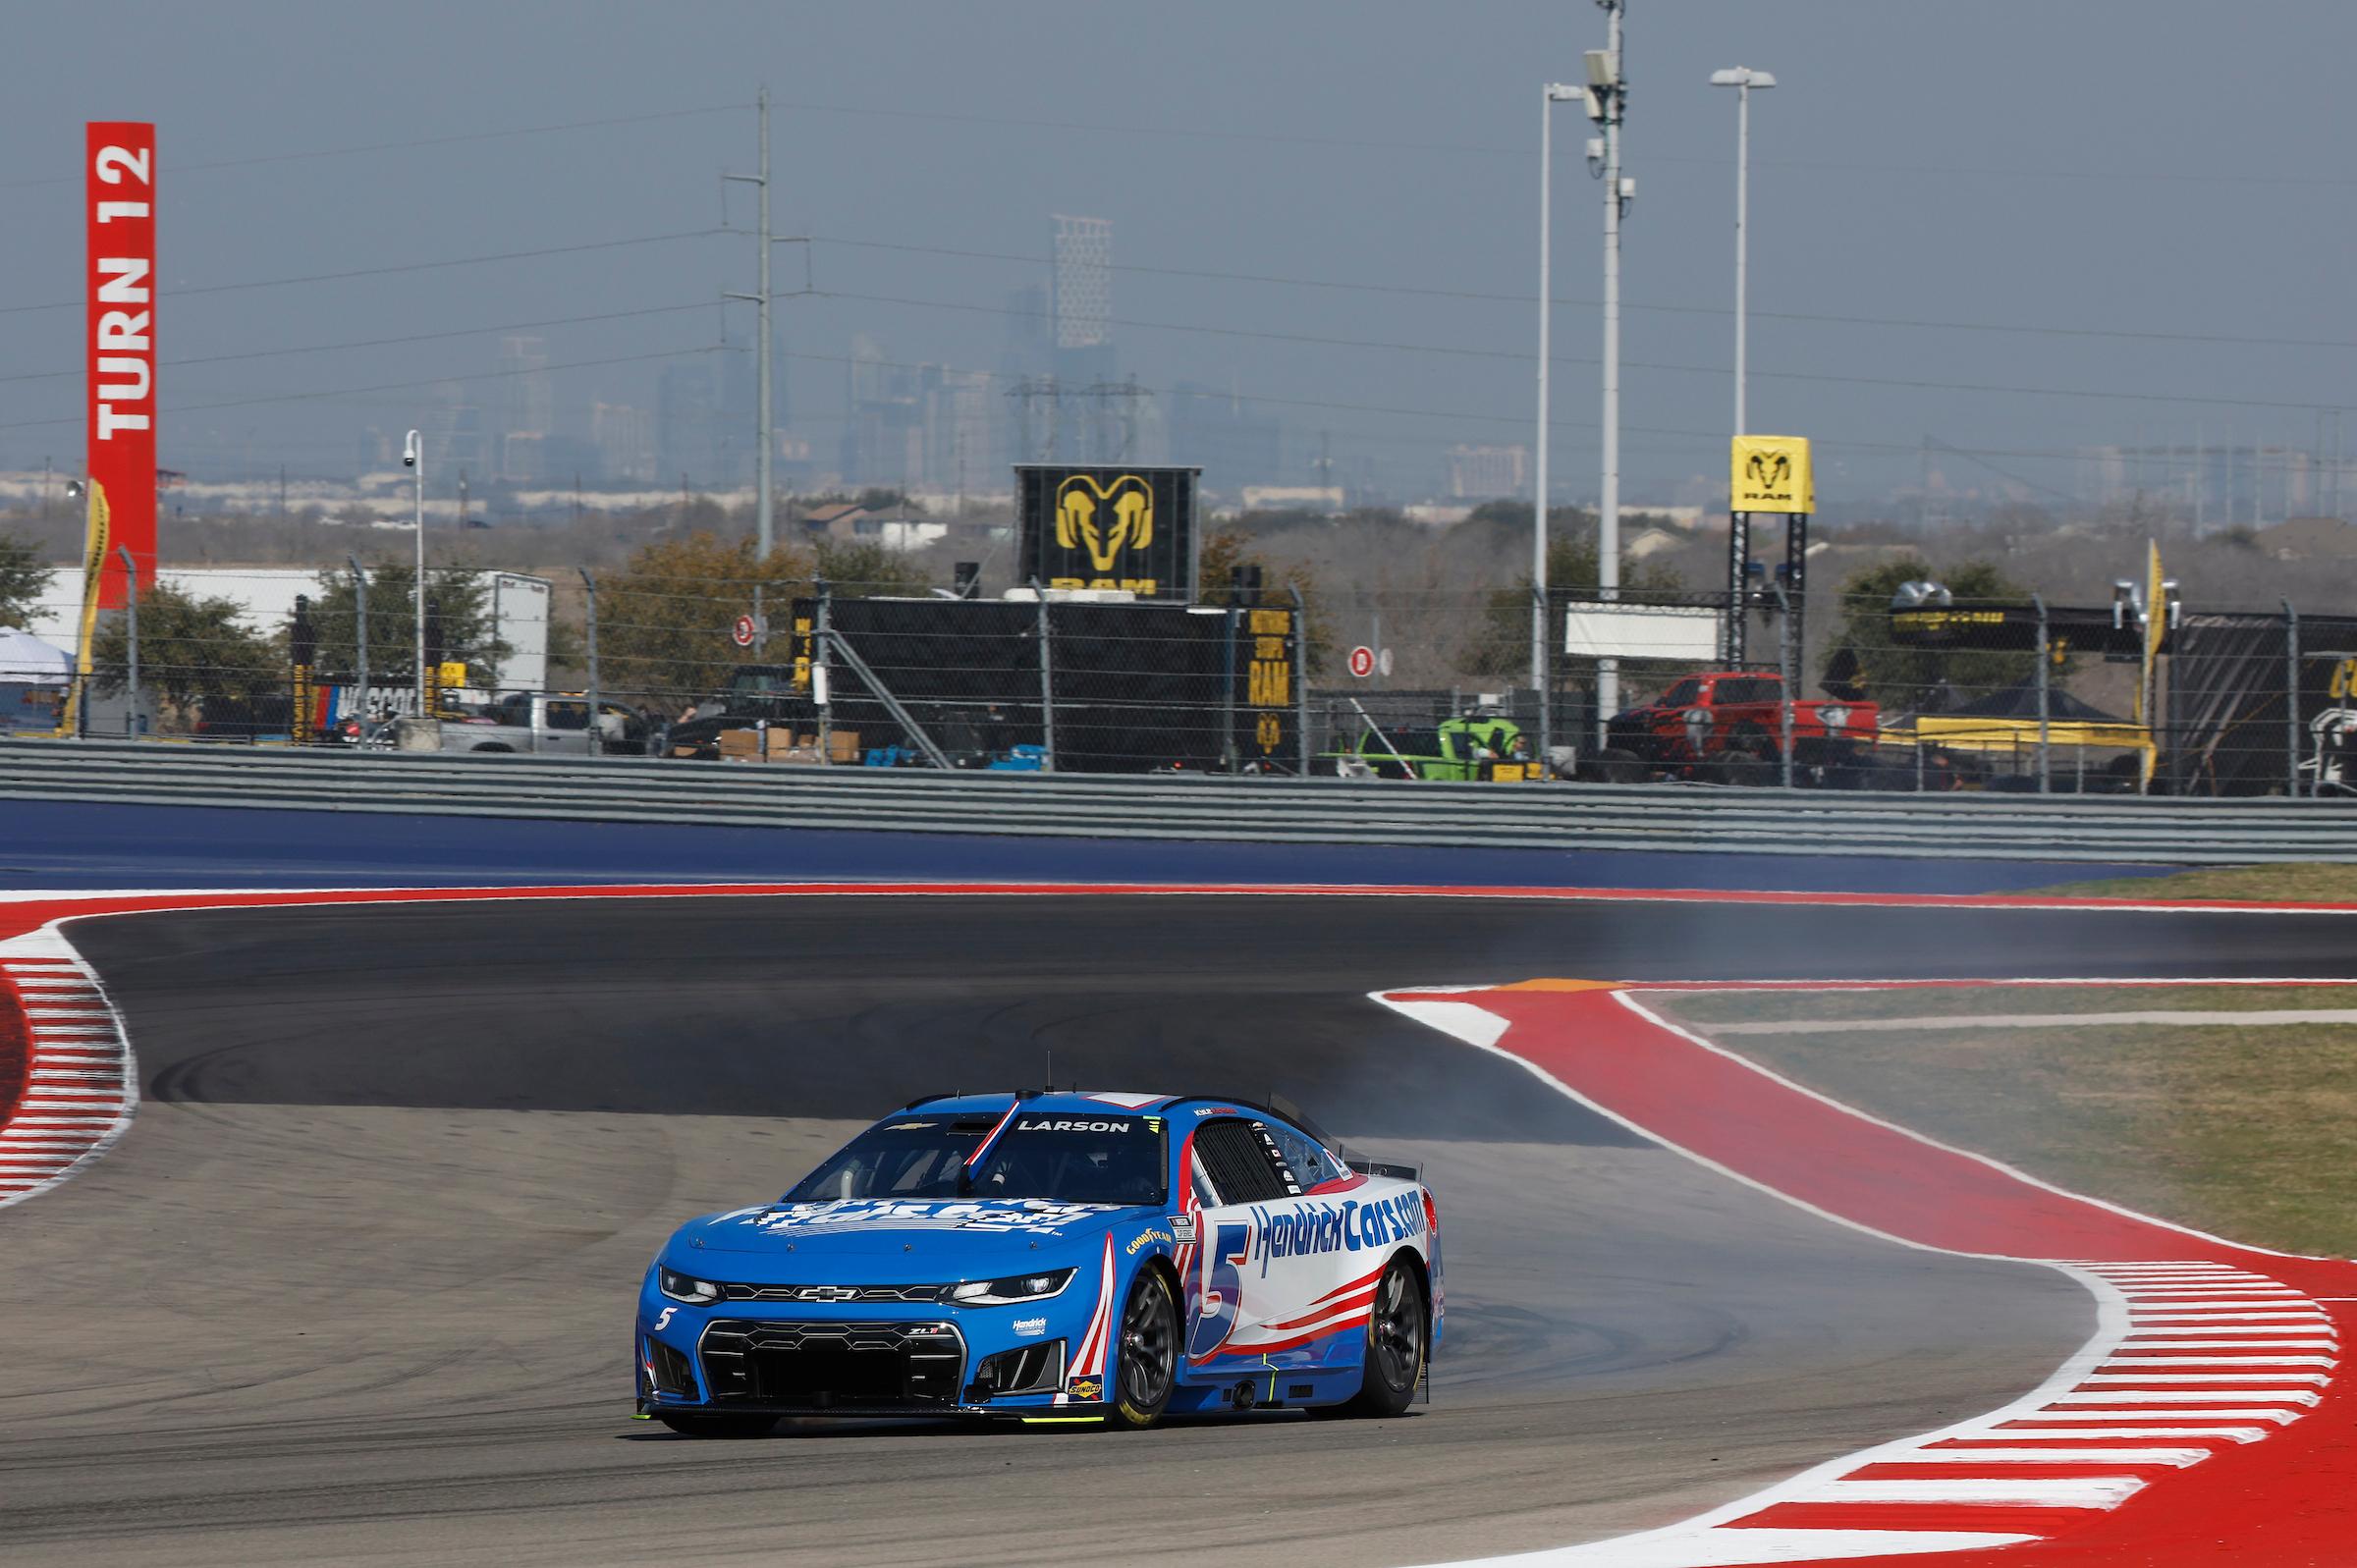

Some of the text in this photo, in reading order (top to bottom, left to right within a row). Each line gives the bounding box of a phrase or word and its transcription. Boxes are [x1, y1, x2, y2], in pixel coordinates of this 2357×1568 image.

[95, 145, 150, 440] TURN 12
[1051, 577, 1156, 595] RAM
[1017, 1120, 1129, 1133] LARSON
[1125, 1228, 1172, 1255] GOODYEAR
[1250, 1190, 1426, 1278] HendrickCars.com
[1188, 1220, 1252, 1360] 5
[654, 1307, 678, 1331] 5
[1013, 1318, 1047, 1331] Hendrick
[1069, 1384, 1101, 1394] SUNOCO
